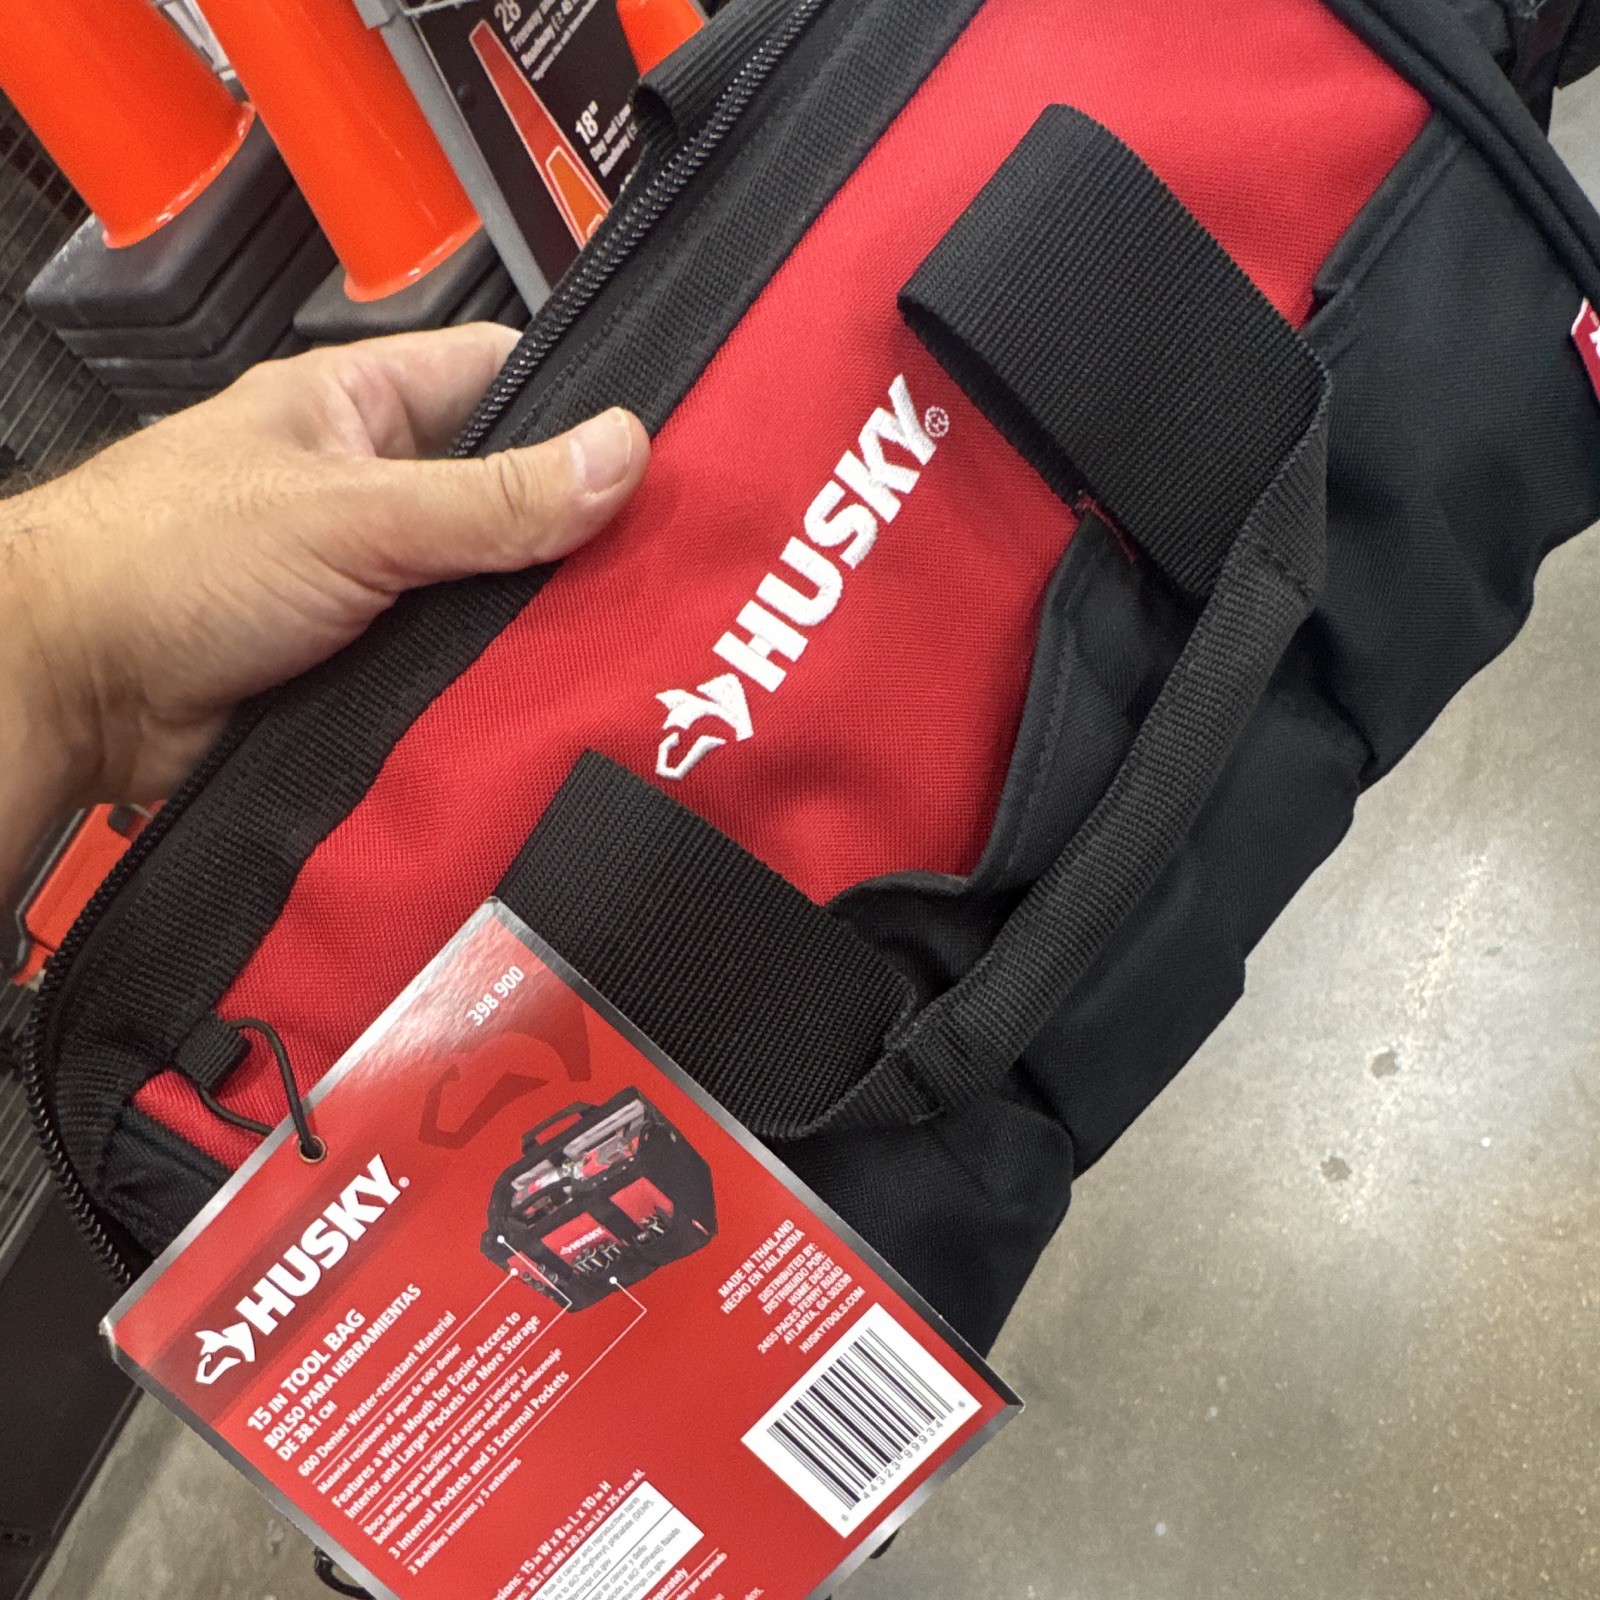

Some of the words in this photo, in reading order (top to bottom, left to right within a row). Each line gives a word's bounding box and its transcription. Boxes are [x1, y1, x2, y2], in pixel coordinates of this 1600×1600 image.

[575, 100, 599, 145] 18"
[712, 373, 937, 692] HUSKY
[467, 993, 499, 1025] 398
[493, 965, 525, 998] 900
[235, 1154, 401, 1336] HUSKY
[719, 1269, 746, 1298] MADE
[741, 1259, 756, 1274] IN
[750, 1219, 795, 1263] THAILAND
[720, 1282, 752, 1314] HECHO
[747, 1270, 764, 1286] EN
[759, 1229, 805, 1273] TAILANDIA
[757, 1253, 806, 1303] DISTRIBUTED
[802, 1243, 816, 1258] BY:
[757, 1331, 779, 1354] 2455
[775, 1308, 801, 1335] PACES
[797, 1285, 823, 1312] FERRY
[819, 1266, 843, 1290] ROAD
[762, 1267, 809, 1315] DISTRIBUIDO
[805, 1251, 827, 1271] POR:
[788, 1281, 812, 1306] HOME
[808, 1257, 834, 1285] DEPOT
[476, 1323, 510, 1358] Access
[505, 1312, 521, 1326] to
[783, 1309, 820, 1345] ATLANTA,
[816, 1296, 831, 1311] GA
[798, 1285, 866, 1354] HUSKYTOOLS.COM
[247, 1406, 272, 1431] 15
[268, 1392, 288, 1413] IN
[280, 1349, 331, 1394] TOOL
[323, 1308, 365, 1352] BAG
[263, 1406, 306, 1449] BOLSO
[300, 1374, 338, 1410] PARA
[331, 1283, 421, 1377] HERRAMIENTAS
[298, 1454, 320, 1476] 600
[315, 1423, 350, 1458] Denier
[345, 1351, 419, 1426] Water-resistant
[413, 1310, 456, 1355] Material
[431, 1383, 451, 1402] for
[446, 1354, 479, 1387] Easier
[276, 1438, 300, 1461] DE
[293, 1415, 322, 1444] 38.1
[318, 1400, 337, 1419] CM
[317, 1458, 352, 1494] Material
[349, 1422, 387, 1462] resistente
[385, 1412, 395, 1425] al
[392, 1394, 414, 1417] agua
[411, 1383, 424, 1397] de
[420, 1367, 439, 1385] 600
[436, 1343, 461, 1371] denier
[344, 1480, 382, 1519] Interior
[380, 1459, 402, 1483] and
[396, 1429, 430, 1464] Larger
[425, 1393, 466, 1433] Pockets
[461, 1377, 480, 1395] for
[475, 1352, 505, 1381] More
[500, 1315, 541, 1355] Storage
[372, 1511, 408, 1545] bolsillos
[420, 1463, 452, 1498] grandes
[449, 1445, 470, 1467] para
[482, 1400, 512, 1431] espacio
[510, 1389, 523, 1402] de
[520, 1348, 562, 1392] almacenaje
[377, 1432, 407, 1459] Wide
[402, 1400, 437, 1434] Mouth
[363, 1514, 386, 1536] Boca
[383, 1491, 408, 1517] ancha
[405, 1472, 426, 1495] para
[421, 1442, 453, 1475] facilitar
[451, 1432, 462, 1445] el
[459, 1409, 486, 1437] acceso
[483, 1398, 494, 1412] al
[489, 1372, 520, 1403] interior
[517, 1366, 527, 1377] y
[372, 1457, 383, 1467] a
[388, 1546, 401, 1559] 3
[396, 1508, 437, 1550] Internal
[431, 1472, 472, 1513] Pockets
[469, 1451, 491, 1475] and
[485, 1444, 498, 1456] 5
[492, 1405, 535, 1448] External
[529, 1371, 569, 1410] Pockets
[331, 1464, 375, 1508] Features
[407, 1565, 418, 1575] 3
[414, 1534, 449, 1568] Bolsillos
[444, 1502, 479, 1536] internos
[475, 1495, 485, 1507] y
[480, 1488, 490, 1499] 5
[488, 1457, 522, 1492] externos
[520, 1560, 535, 1574] 15
[537, 1541, 552, 1556] W
[549, 1536, 559, 1547] x
[554, 1528, 566, 1539] 8
[568, 1516, 580, 1525] L
[576, 1509, 586, 1519] x
[581, 1496, 597, 1510] 10
[599, 1481, 612, 1493] H
[551, 1549, 566, 1565] AN
[563, 1546, 571, 1554] x
[567, 1528, 586, 1548] 20.3
[592, 1509, 606, 1522] LA
[603, 1504, 611, 1512] x
